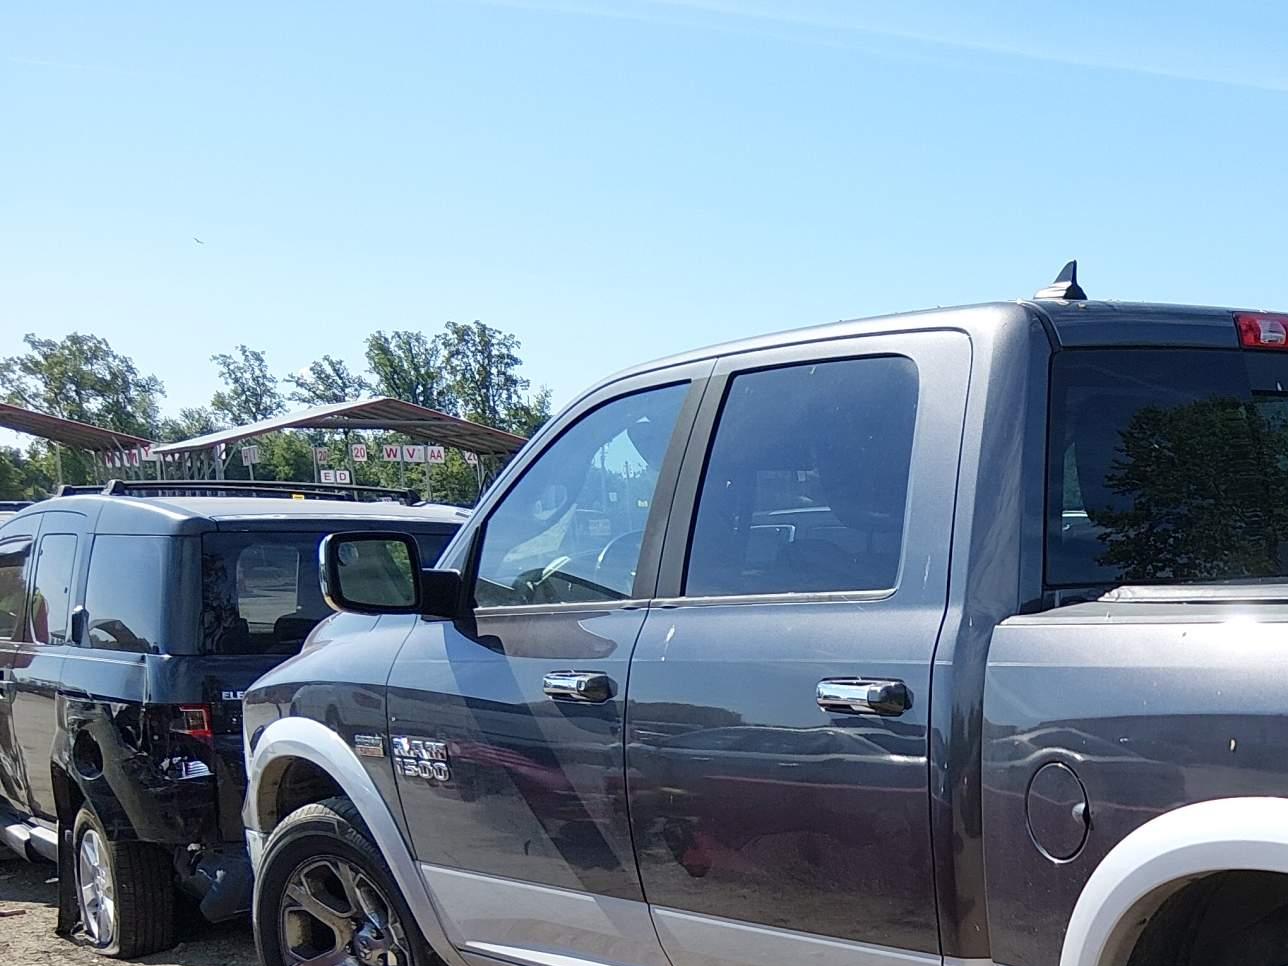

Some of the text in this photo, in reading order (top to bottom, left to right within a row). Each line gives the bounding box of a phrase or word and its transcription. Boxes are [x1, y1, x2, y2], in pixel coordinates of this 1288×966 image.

[353, 447, 365, 459] 20
[385, 447, 399, 459] W
[430, 450, 443, 460] AA
[392, 737, 448, 760] RAM
[396, 757, 449, 781] 1500
